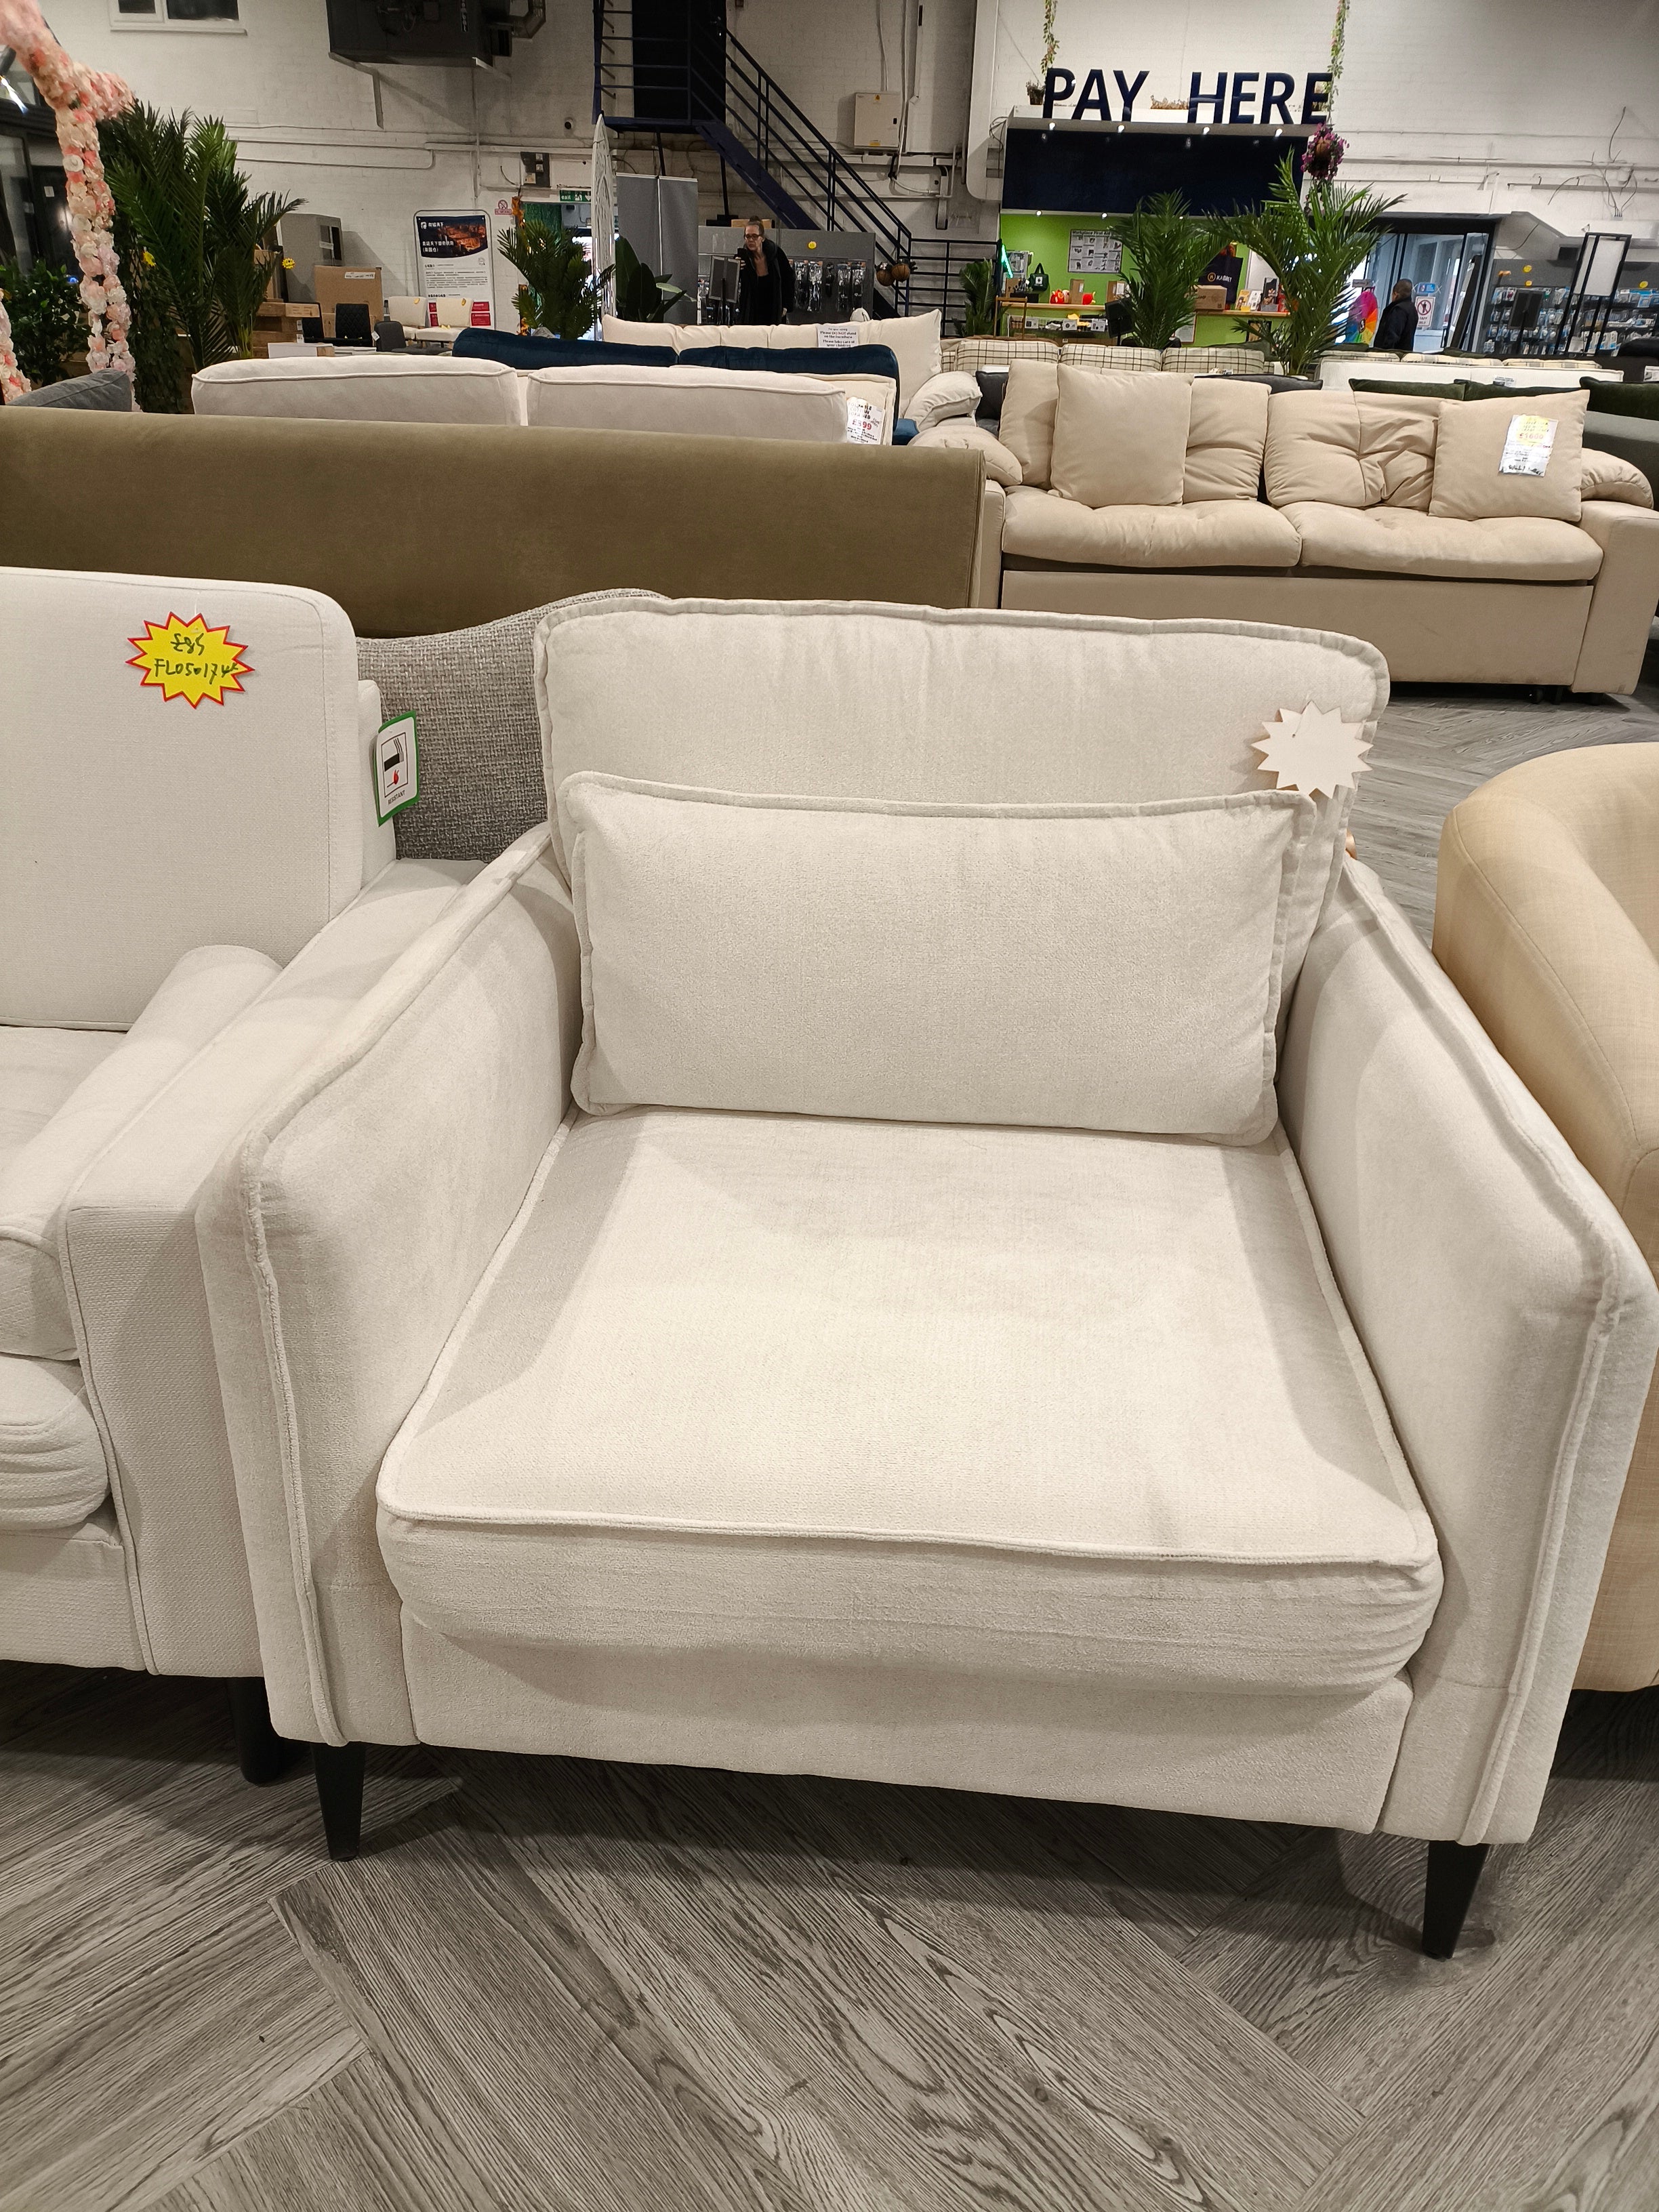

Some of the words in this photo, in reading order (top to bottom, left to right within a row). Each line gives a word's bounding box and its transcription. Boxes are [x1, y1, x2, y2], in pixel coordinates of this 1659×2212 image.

[1042, 68, 1149, 122] PAY
[1187, 71, 1333, 125] HERE
[852, 418, 872, 430] £399
[388, 790, 405, 805] RESISTANT
